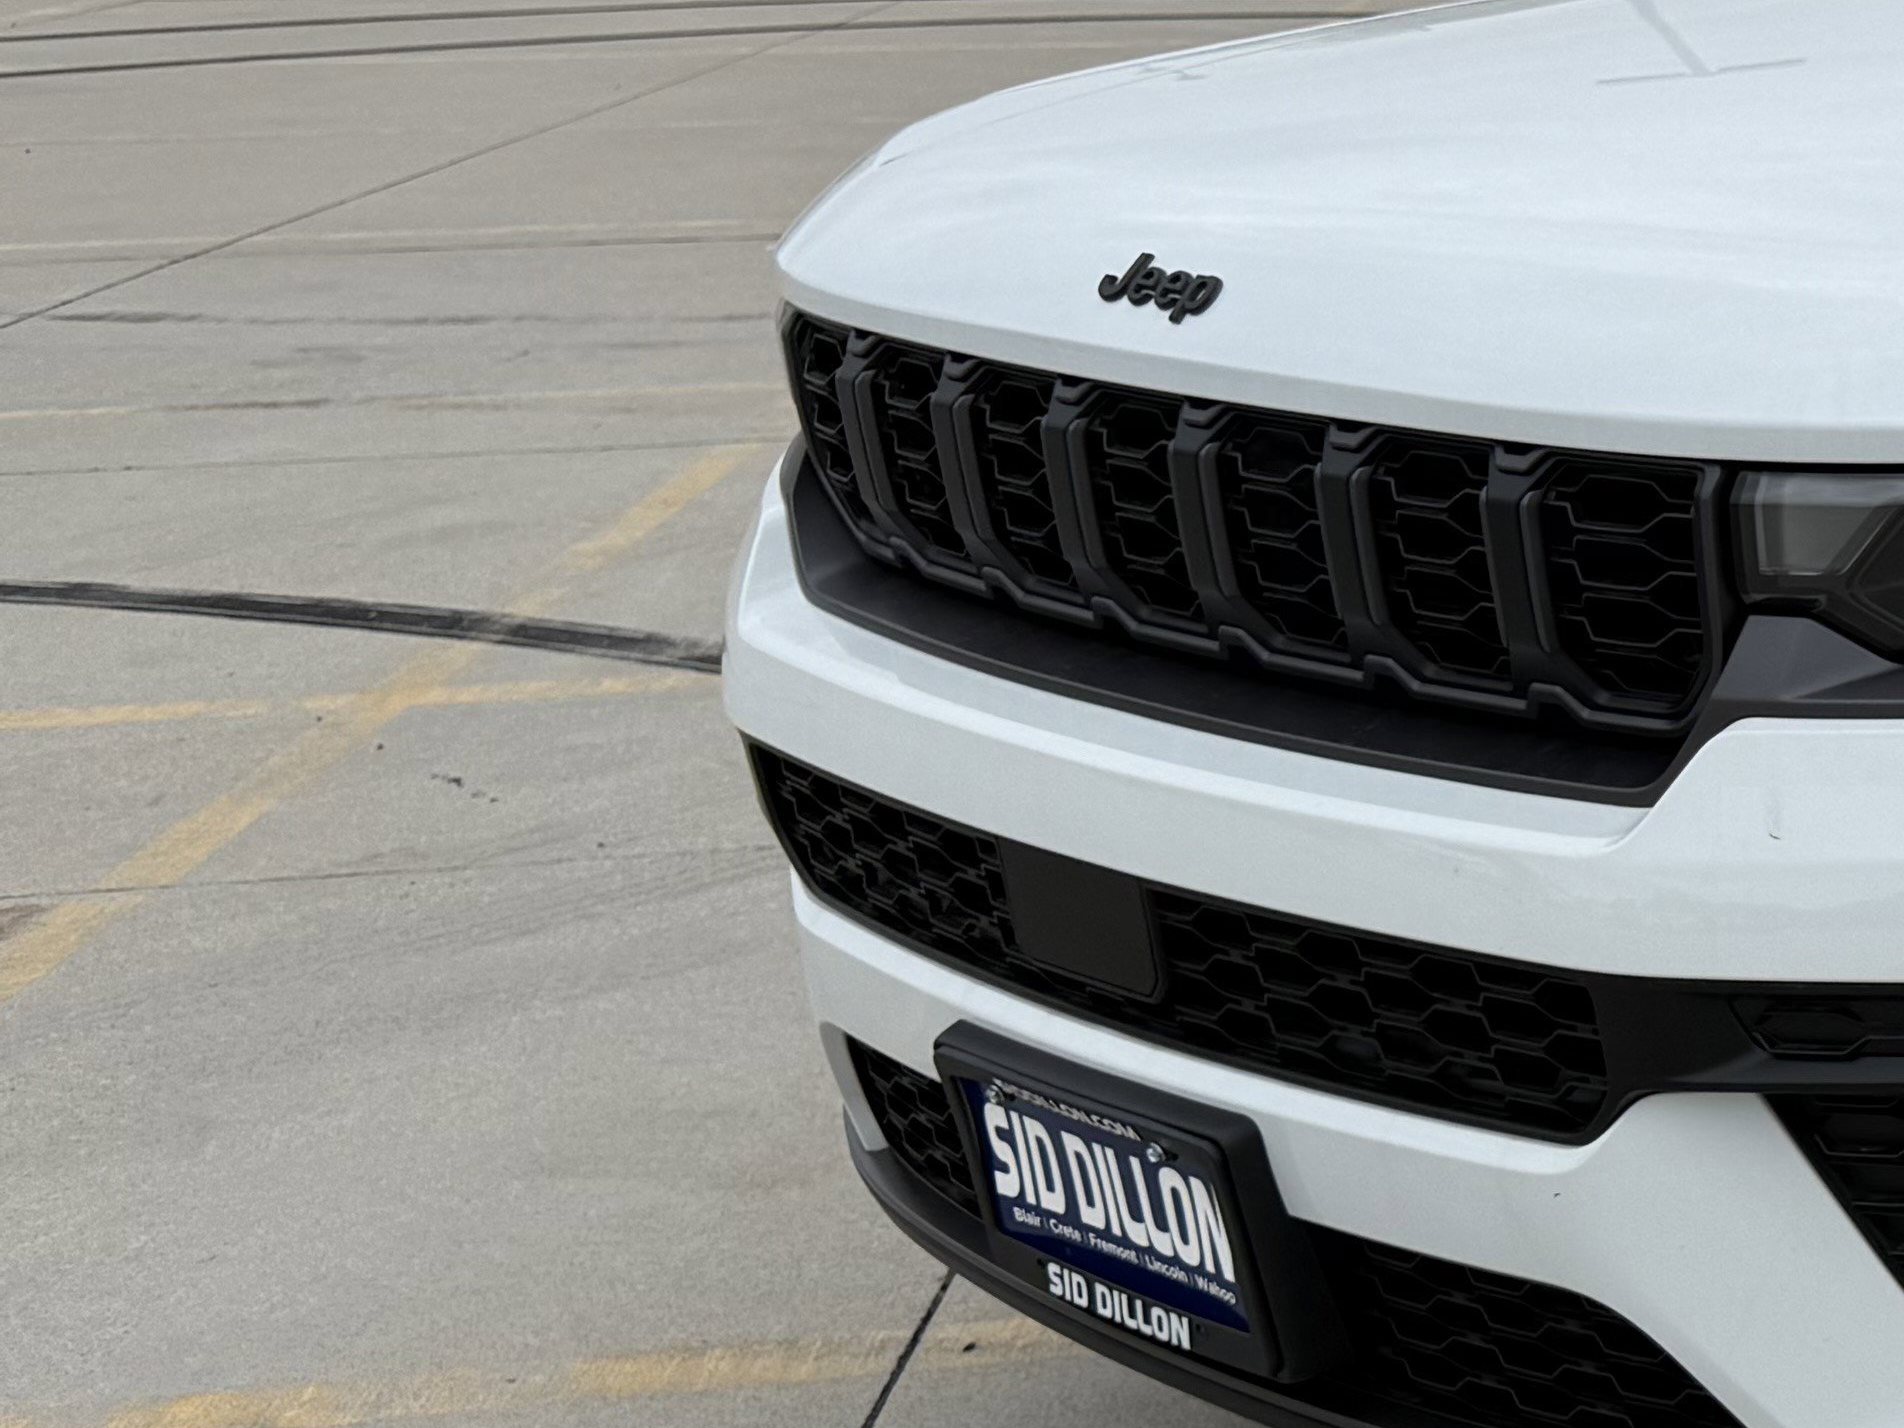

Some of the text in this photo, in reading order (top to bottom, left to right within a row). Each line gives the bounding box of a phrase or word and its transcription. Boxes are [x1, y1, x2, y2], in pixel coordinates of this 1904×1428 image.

[1097, 252, 1225, 325] Jeep
[983, 1102, 1237, 1284] SID DILLON
[1012, 1206, 1238, 1306] Blair Crete Fremont Lincoln Wahoo
[1046, 1261, 1192, 1351] SID DILLON
